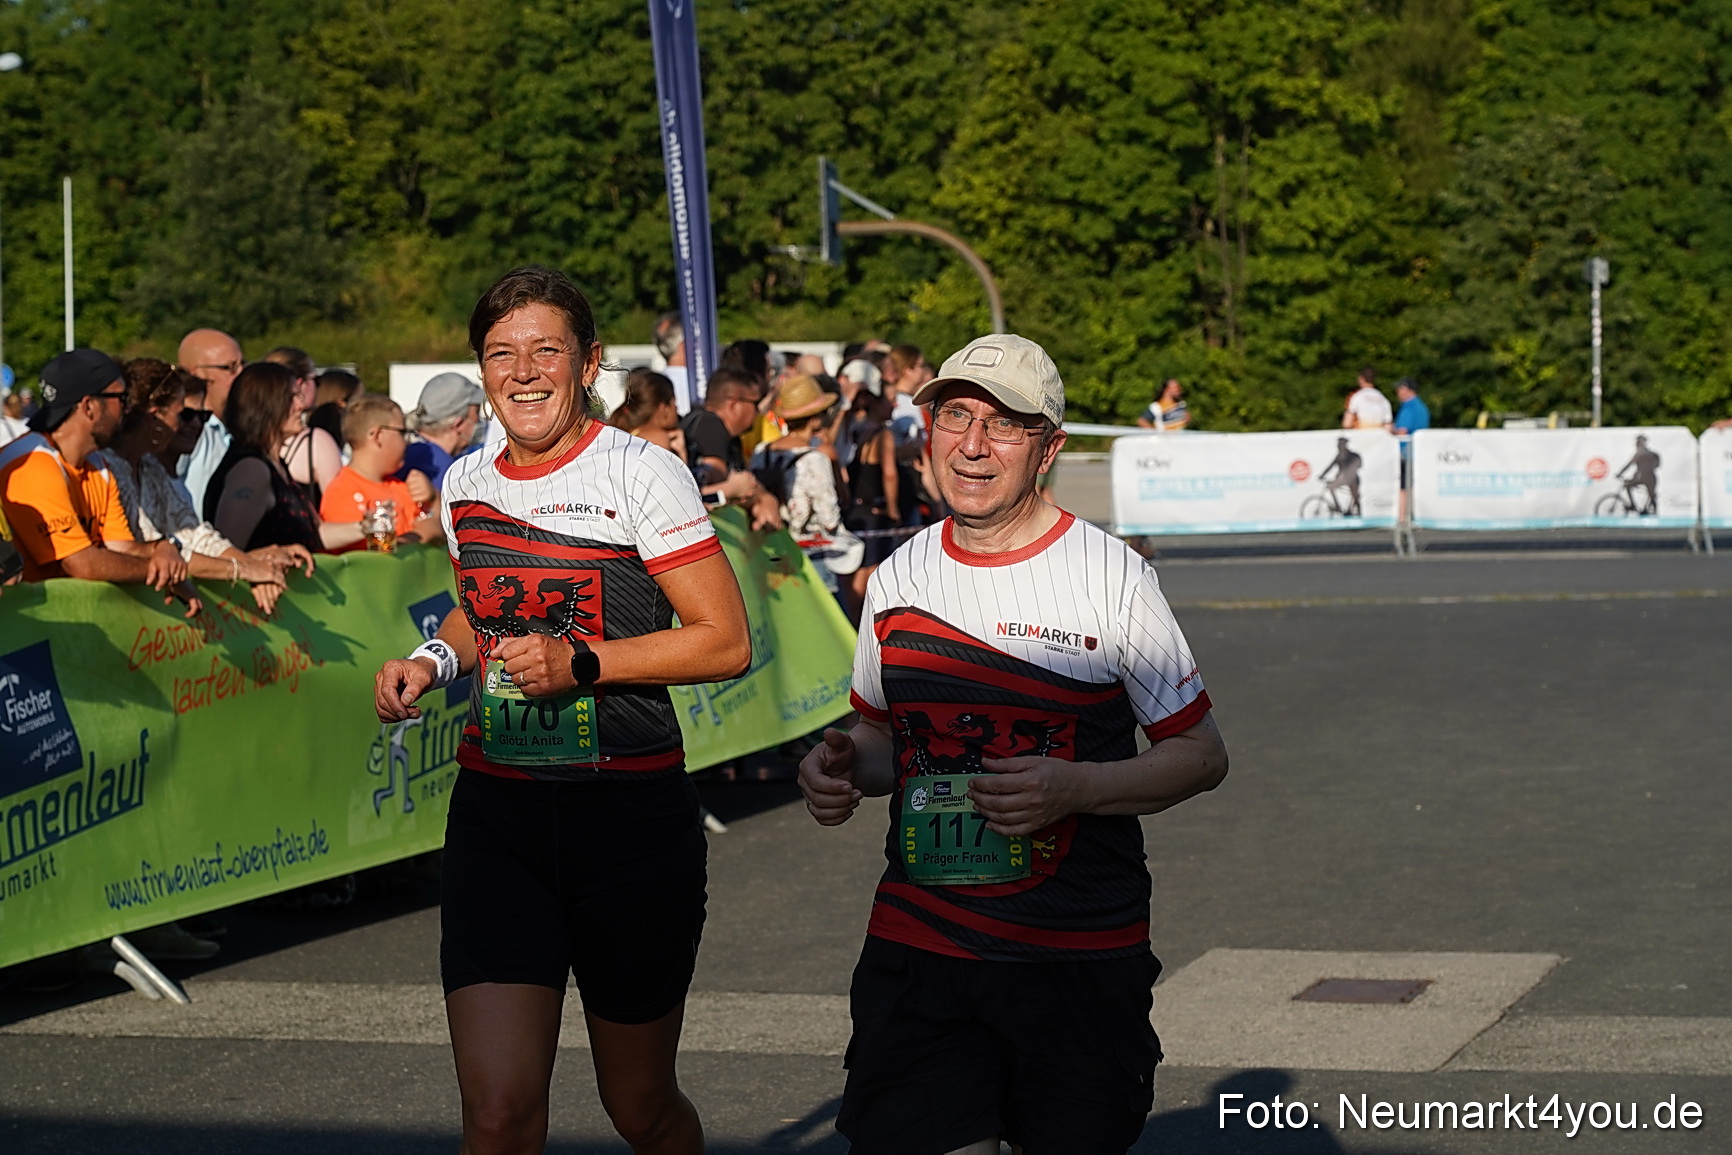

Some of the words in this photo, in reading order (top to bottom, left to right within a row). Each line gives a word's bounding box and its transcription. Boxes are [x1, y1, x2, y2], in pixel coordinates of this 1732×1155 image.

[531, 503, 601, 515] NEUMARKT
[996, 621, 1081, 648] NEUMARKT
[1044, 644, 1064, 654] STARKE
[1064, 648, 1081, 657] STADT
[172, 655, 246, 715] laufen
[5, 689, 52, 724] Fischer
[17, 711, 56, 736] AUTOMOBILE
[498, 698, 560, 732] 170
[484, 706, 492, 742] RUN
[499, 733, 529, 747] Glötzl
[531, 734, 564, 747] Anita
[575, 700, 592, 748] 2022
[0, 728, 149, 862] menlauf
[928, 793, 966, 805] Firmenlauf
[906, 826, 917, 864] RUN
[928, 813, 991, 848] 117
[104, 818, 330, 911] www.firmenlauf-oberpfalz.de
[923, 853, 959, 867] Präger
[961, 852, 999, 864] Frank
